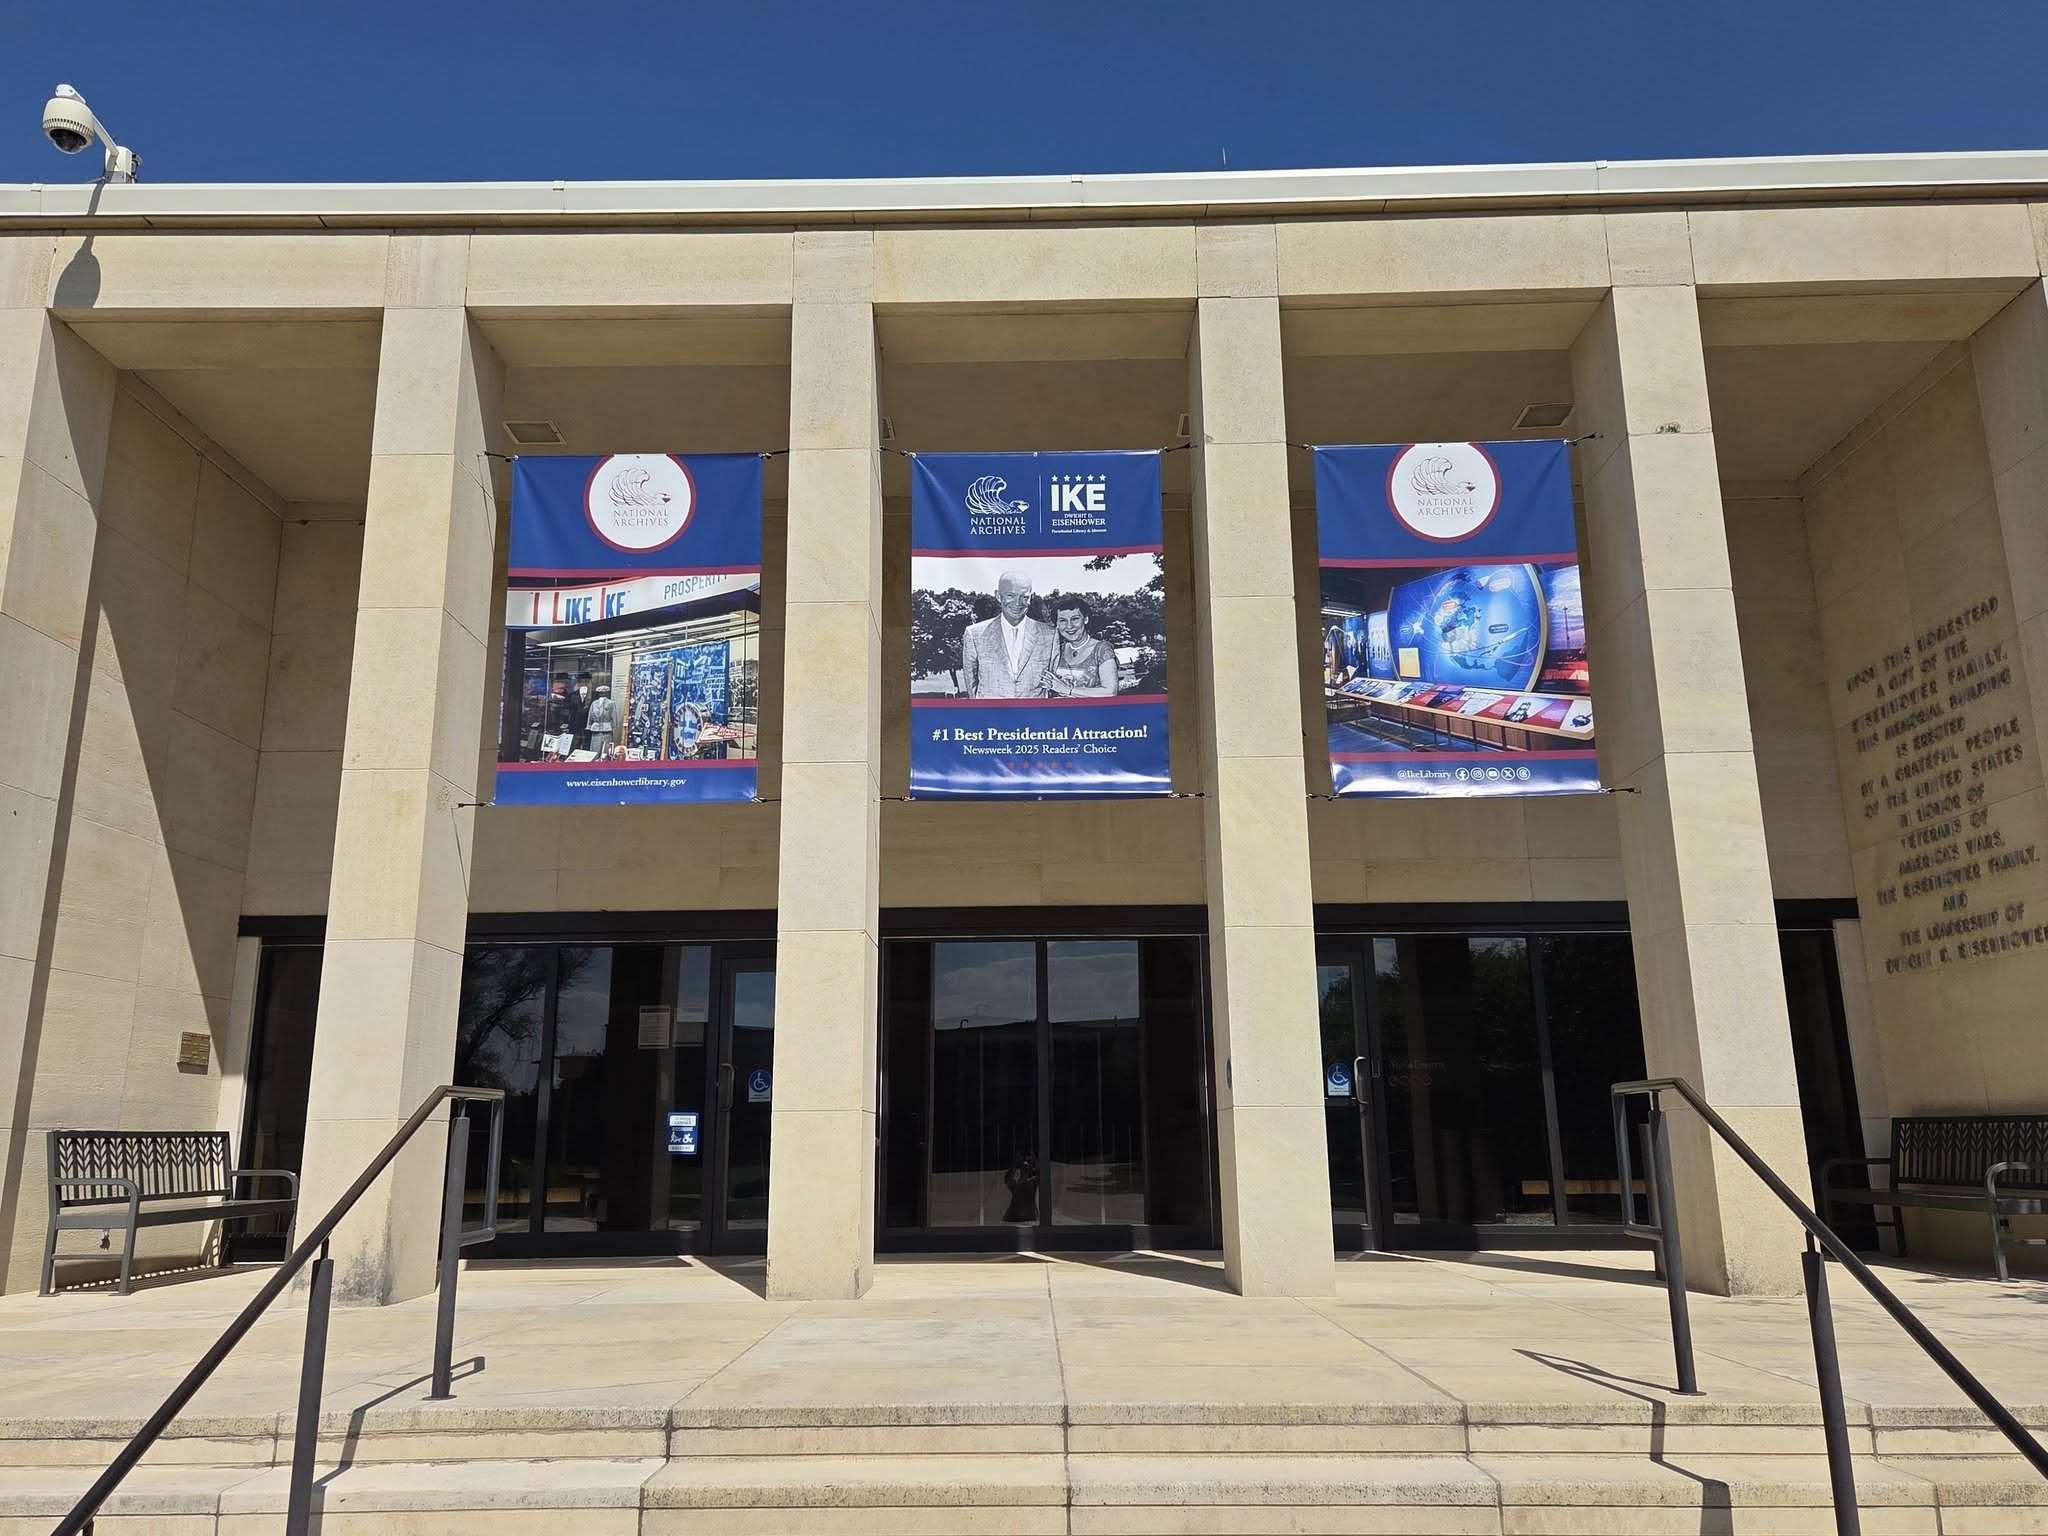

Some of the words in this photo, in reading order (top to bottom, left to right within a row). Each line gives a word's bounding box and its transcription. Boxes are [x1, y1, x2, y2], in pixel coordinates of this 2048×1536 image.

[1051, 483, 1106, 512] IKE
[1417, 498, 1473, 506] NATIONAL
[613, 508, 669, 518] NATIONAL
[613, 518, 670, 527] ARCHIVES
[970, 517, 1026, 526] NATIONAL
[1052, 518, 1106, 527] EISENHOWER
[1417, 507, 1475, 516] ARCHIVES
[970, 526, 1026, 535] ARCHIVES
[552, 591, 592, 625] LIKE
[1847, 664, 1877, 692] UPON
[1884, 646, 1911, 672] THIS
[1917, 595, 1999, 652] HOMESTEAD
[1876, 683, 1885, 699] A
[1889, 665, 1914, 691] GIFT
[1919, 653, 1937, 673] OF
[1944, 638, 1968, 662] THE
[1851, 679, 1938, 733] EISENHOWER
[1856, 732, 1879, 754] THIS
[1884, 702, 1944, 740] MEMORIAL
[1949, 667, 2011, 710] BUILDING
[932, 728, 949, 741] #1
[954, 727, 983, 741] Best
[988, 726, 1069, 741] Presidential
[1072, 725, 1148, 740] Attraction!
[1896, 742, 1908, 759] IS
[1912, 716, 1966, 750] ERECTED
[963, 744, 1013, 755] Newsweek
[1015, 744, 1039, 754] 2025
[1083, 743, 1117, 754] Choice
[1860, 779, 1874, 797] BY
[1880, 774, 1889, 789] A
[1894, 744, 1959, 783] GRATEFUL
[1965, 715, 2020, 753] PEOPLE
[566, 777, 687, 788] www.eisenhowerlibrary.gov
[1397, 769, 1451, 779] @IkeLibrary
[1864, 800, 1879, 819] OF
[1886, 788, 1908, 810] THE
[1914, 768, 1963, 799] UNITED
[1971, 742, 2023, 777] STATES
[1898, 811, 1912, 828] IN
[1916, 794, 1962, 822] HONOR
[1966, 782, 1984, 803] OF
[1901, 817, 1963, 849] VETERANS
[1969, 807, 1988, 829] OF
[1877, 885, 1898, 907] THE
[1902, 862, 1981, 900] EISENHOWER
[1942, 891, 1969, 912] AND
[1900, 928, 1921, 947] THE
[1926, 910, 2000, 942] LEADERSHIP
[2004, 901, 2024, 923] OF
[1886, 949, 1932, 975] DWIGHT
